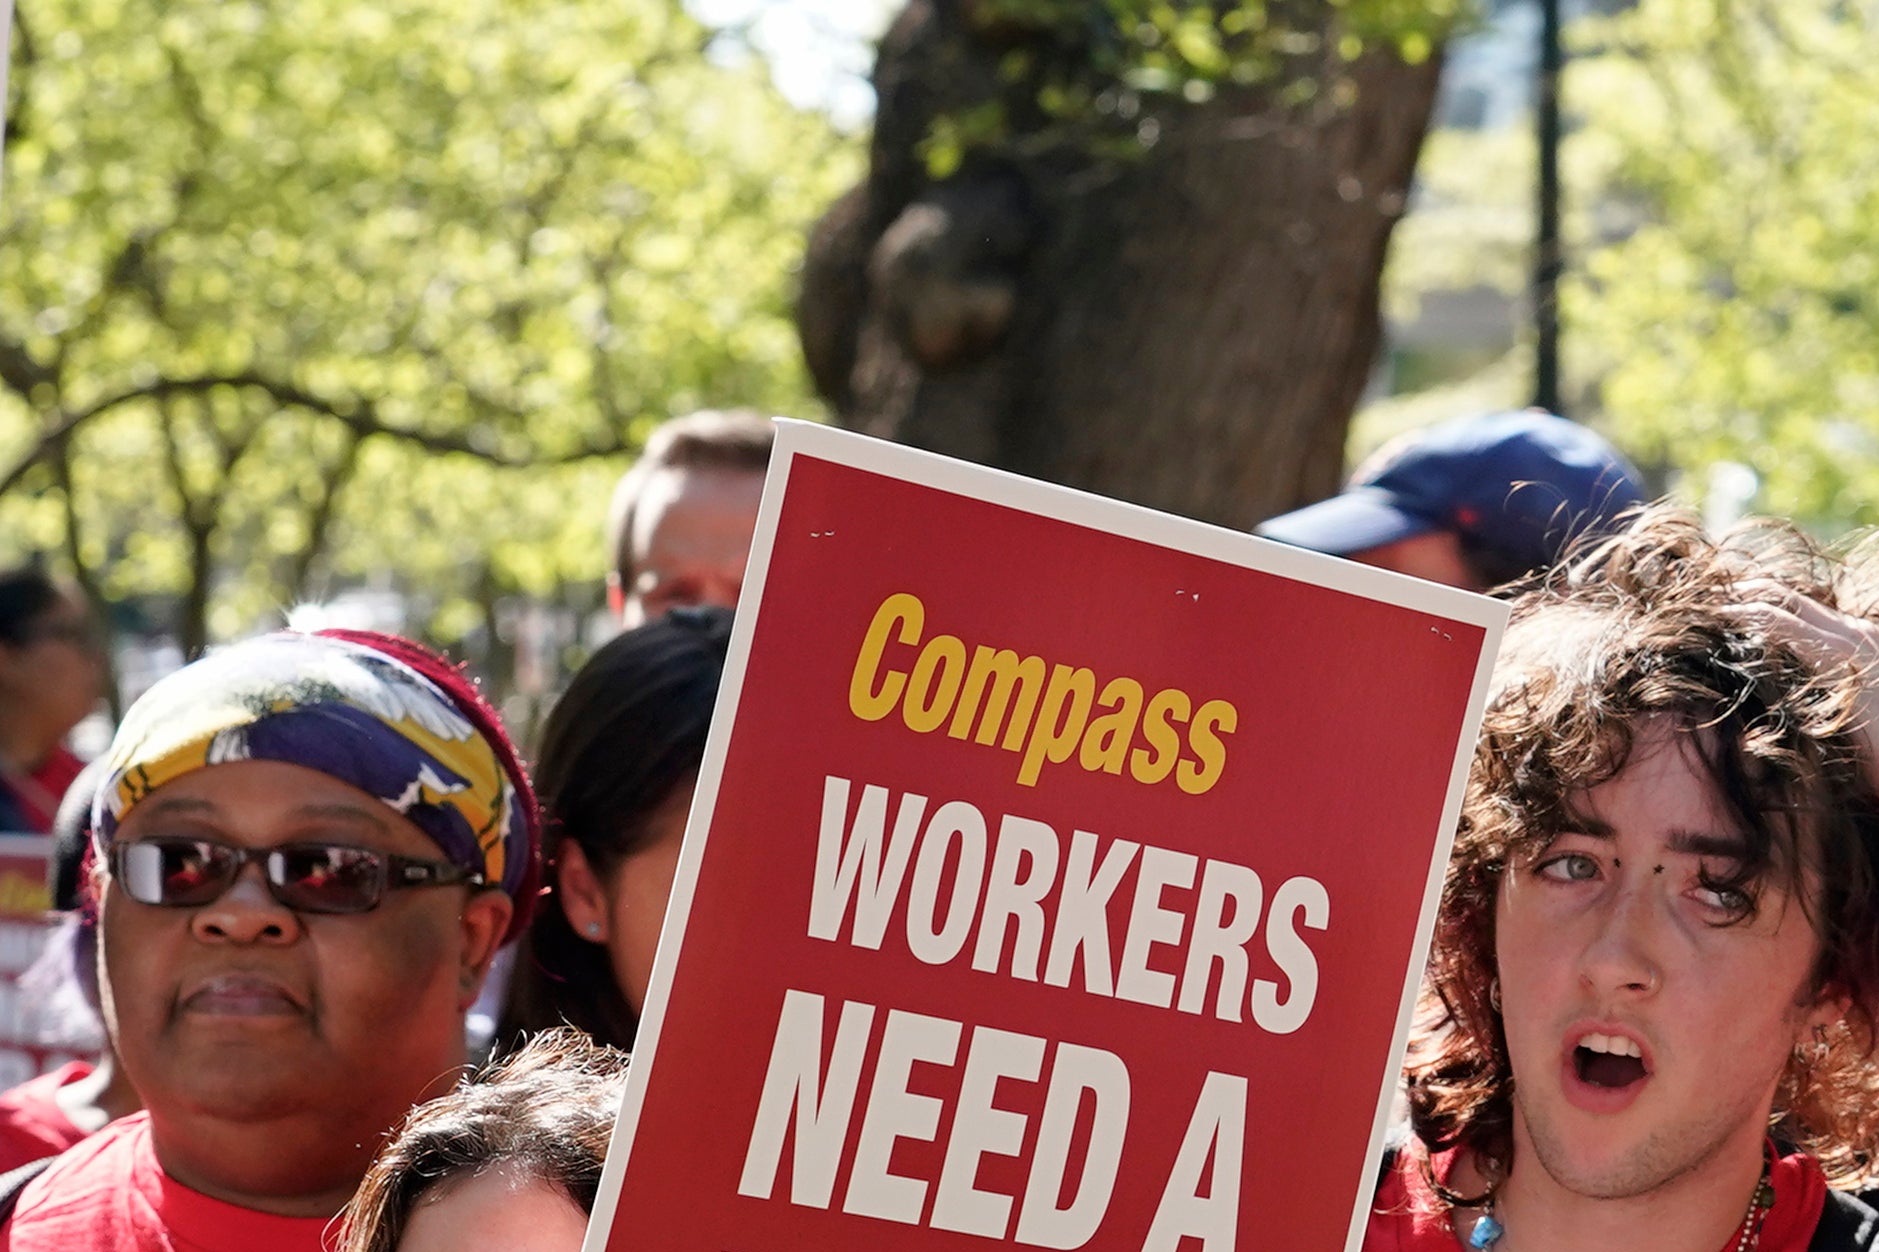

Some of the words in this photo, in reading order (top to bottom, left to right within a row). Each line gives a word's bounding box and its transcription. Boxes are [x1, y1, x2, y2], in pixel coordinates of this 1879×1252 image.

[848, 592, 1239, 795] Compass
[806, 775, 1330, 1035] WORKERS
[737, 988, 1133, 1252] NEED
